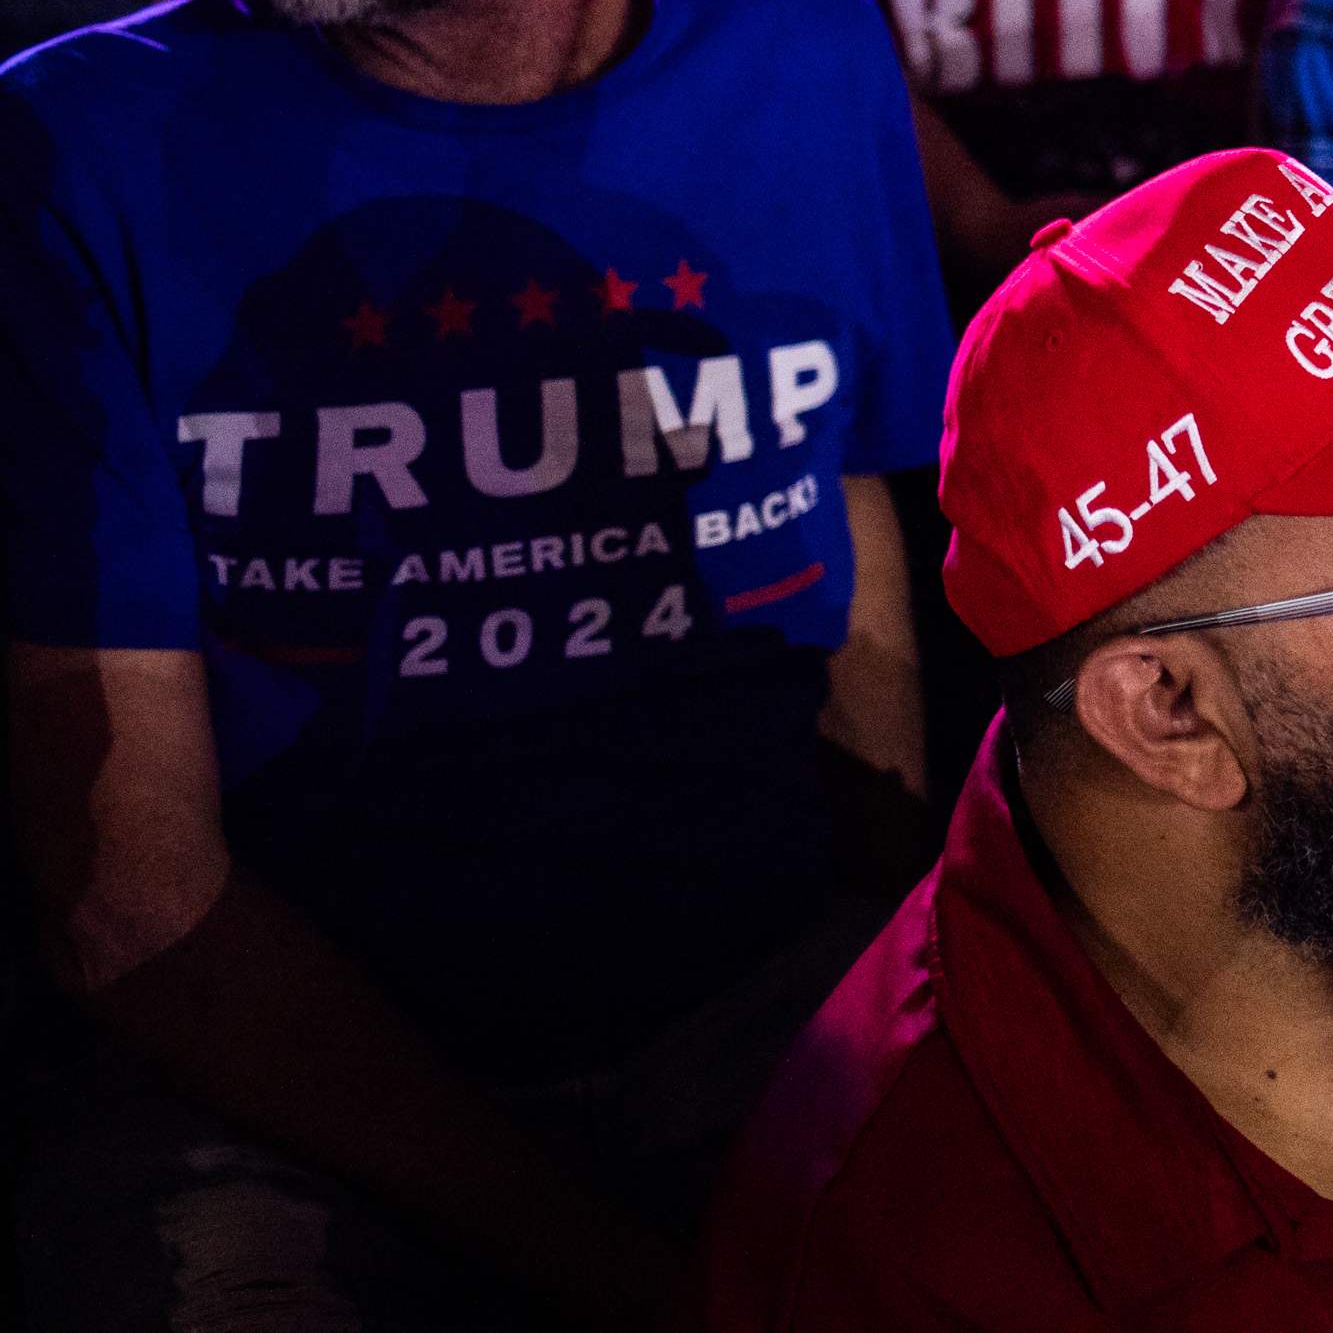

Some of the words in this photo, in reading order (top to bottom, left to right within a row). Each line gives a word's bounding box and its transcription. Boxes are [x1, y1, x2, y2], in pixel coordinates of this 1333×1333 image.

[1167, 193, 1306, 325] MAKE
[177, 339, 840, 516] TRUMP
[1057, 412, 1218, 570] 45-47
[208, 553, 364, 591] TAKE
[392, 523, 671, 587] AMERICA
[399, 585, 693, 678] 2024
